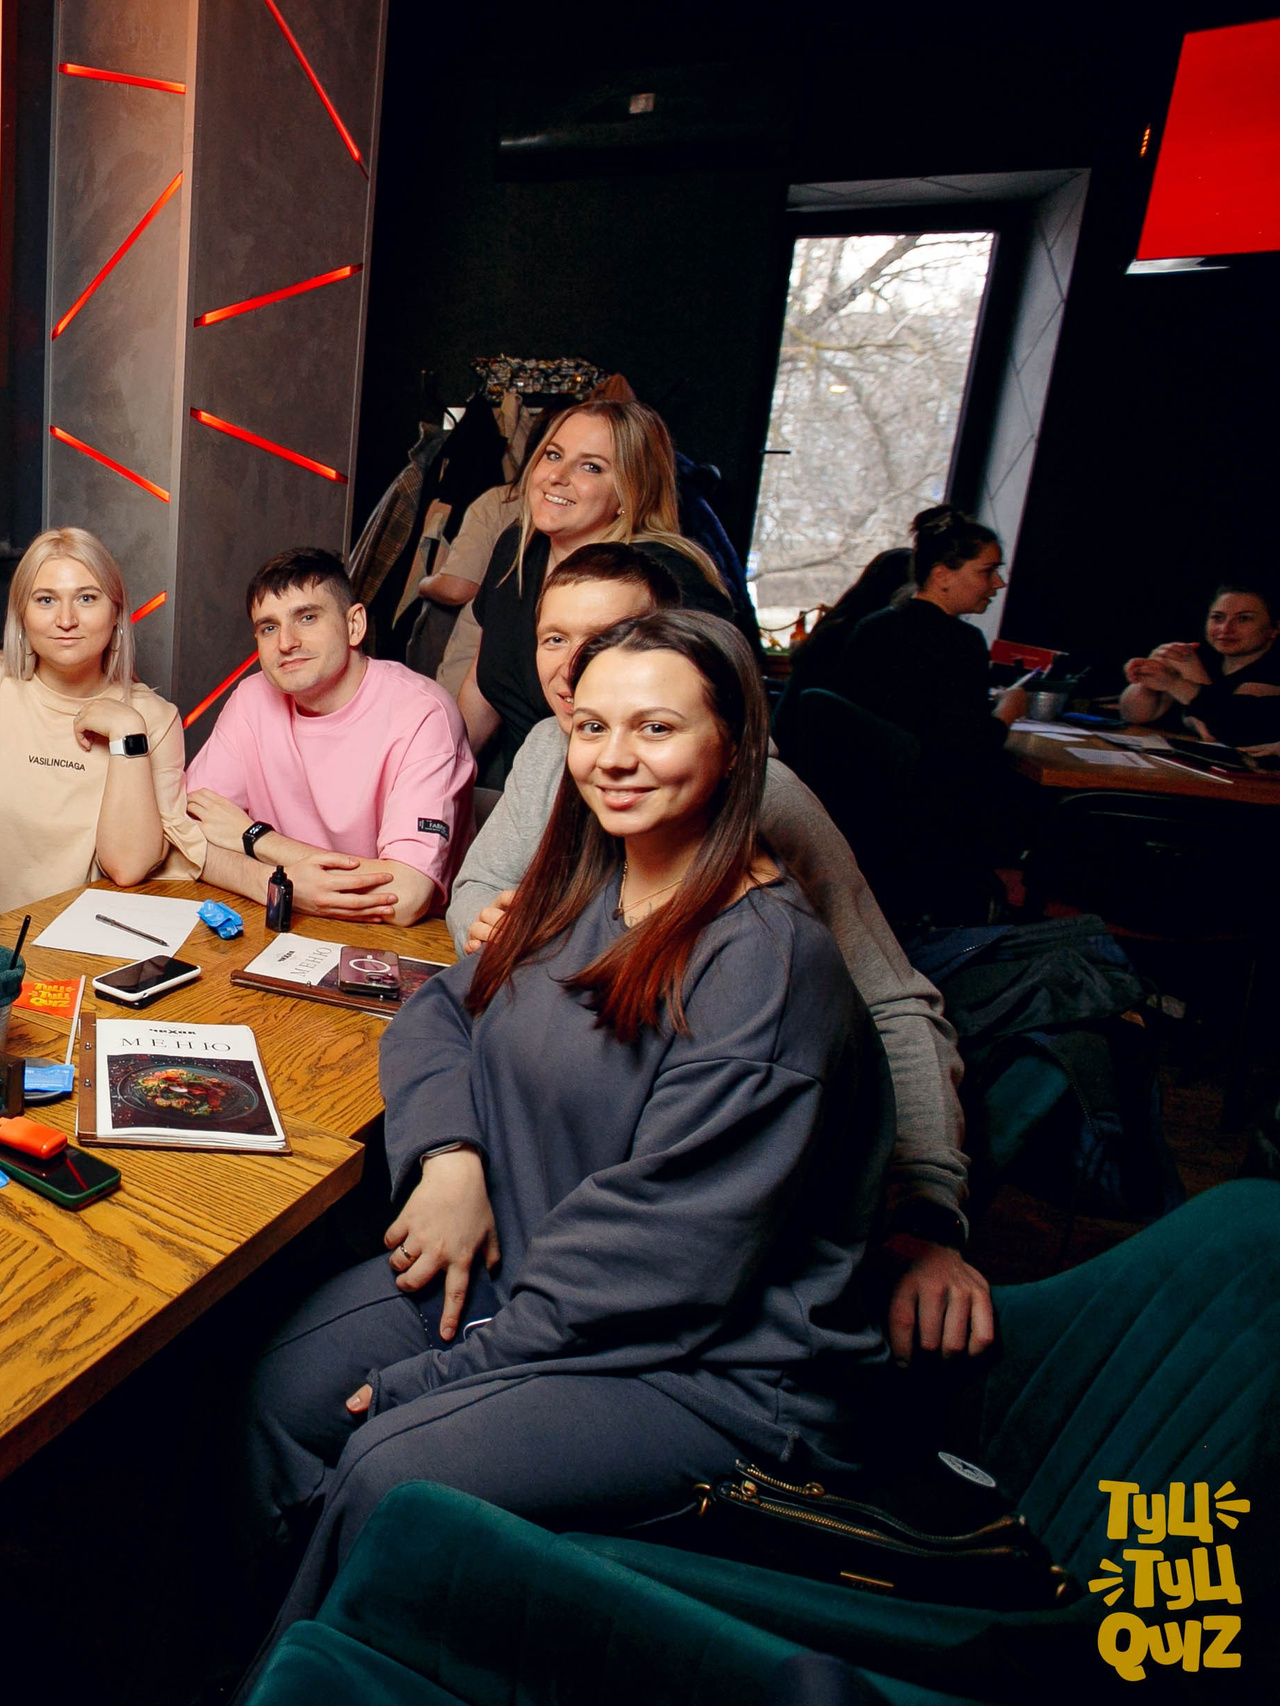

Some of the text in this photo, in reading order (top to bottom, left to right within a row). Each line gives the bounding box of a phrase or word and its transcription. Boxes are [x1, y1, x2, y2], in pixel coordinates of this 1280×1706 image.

[28, 755, 86, 771] VASILINCIAGA
[290, 947, 332, 977] МЕНЮ
[121, 1038, 231, 1052] МЕНЮ
